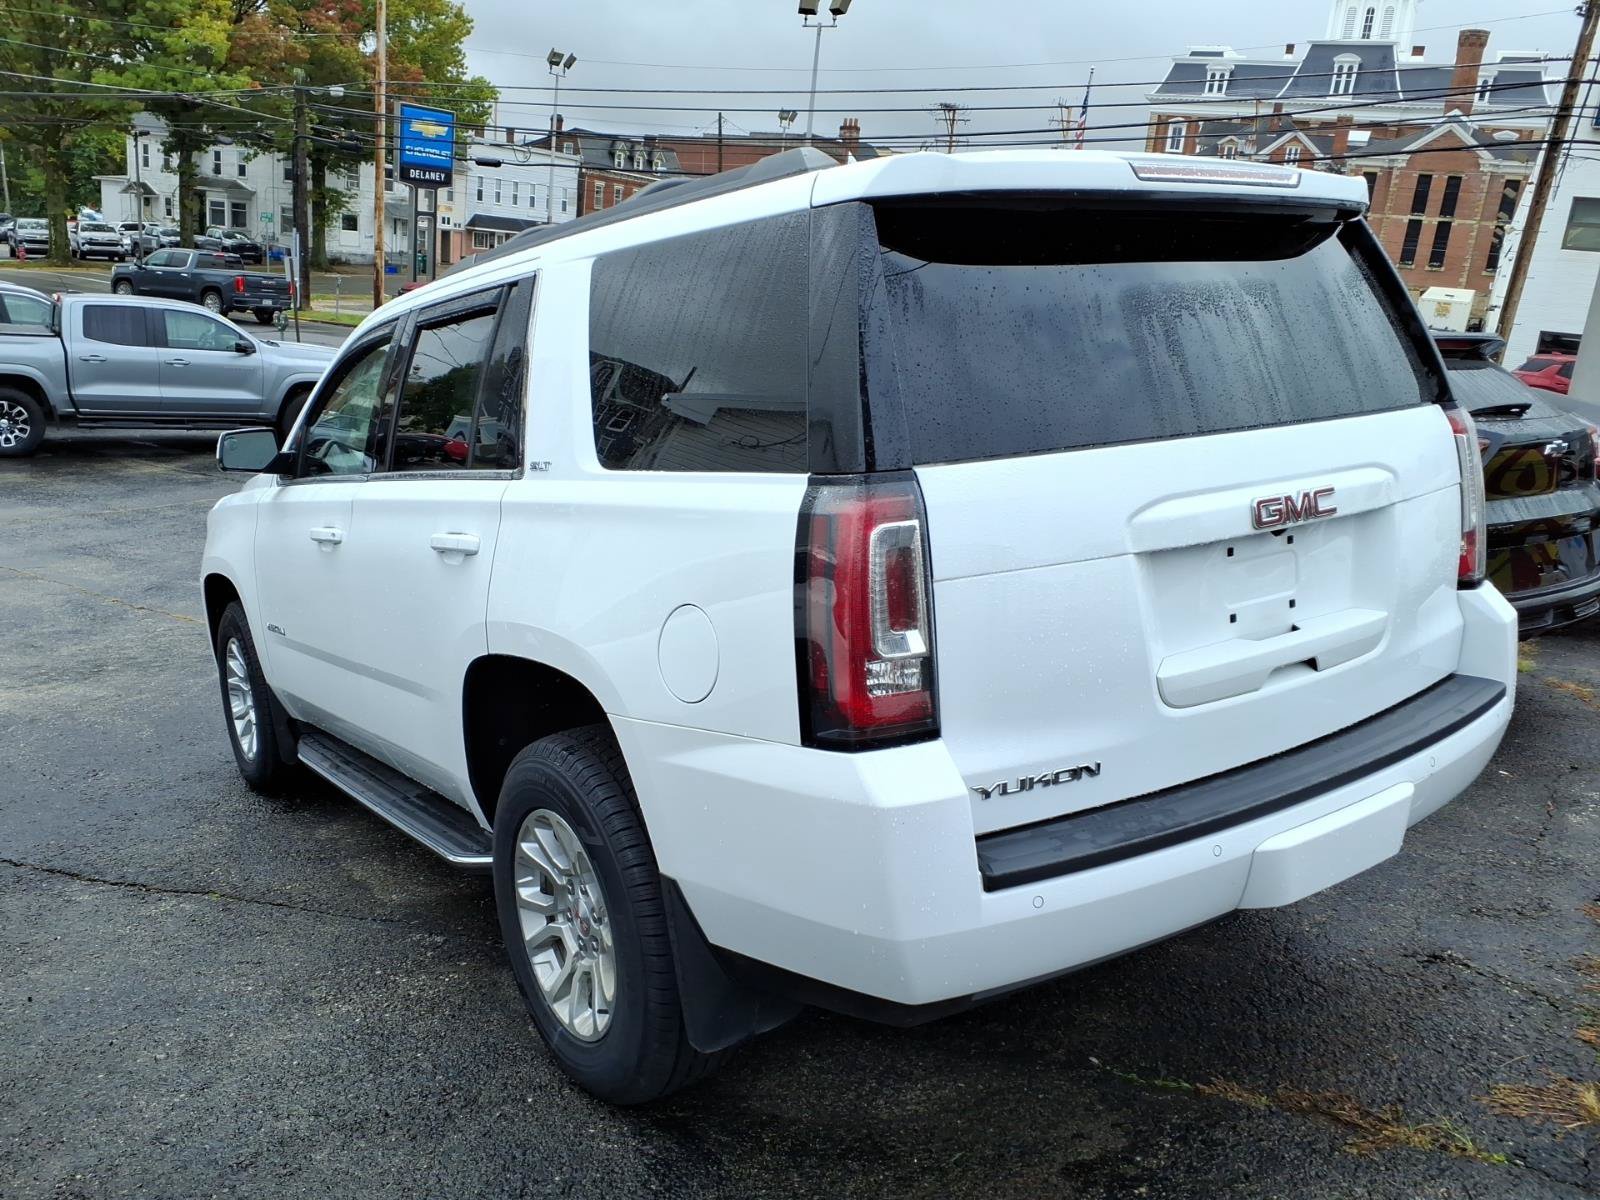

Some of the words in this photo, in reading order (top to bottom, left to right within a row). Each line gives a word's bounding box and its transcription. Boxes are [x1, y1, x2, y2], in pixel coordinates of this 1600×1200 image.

[409, 168, 446, 181] DELANEY
[529, 461, 552, 472] SLT
[1251, 485, 1337, 530] GMC
[970, 761, 1102, 800] YUKON
